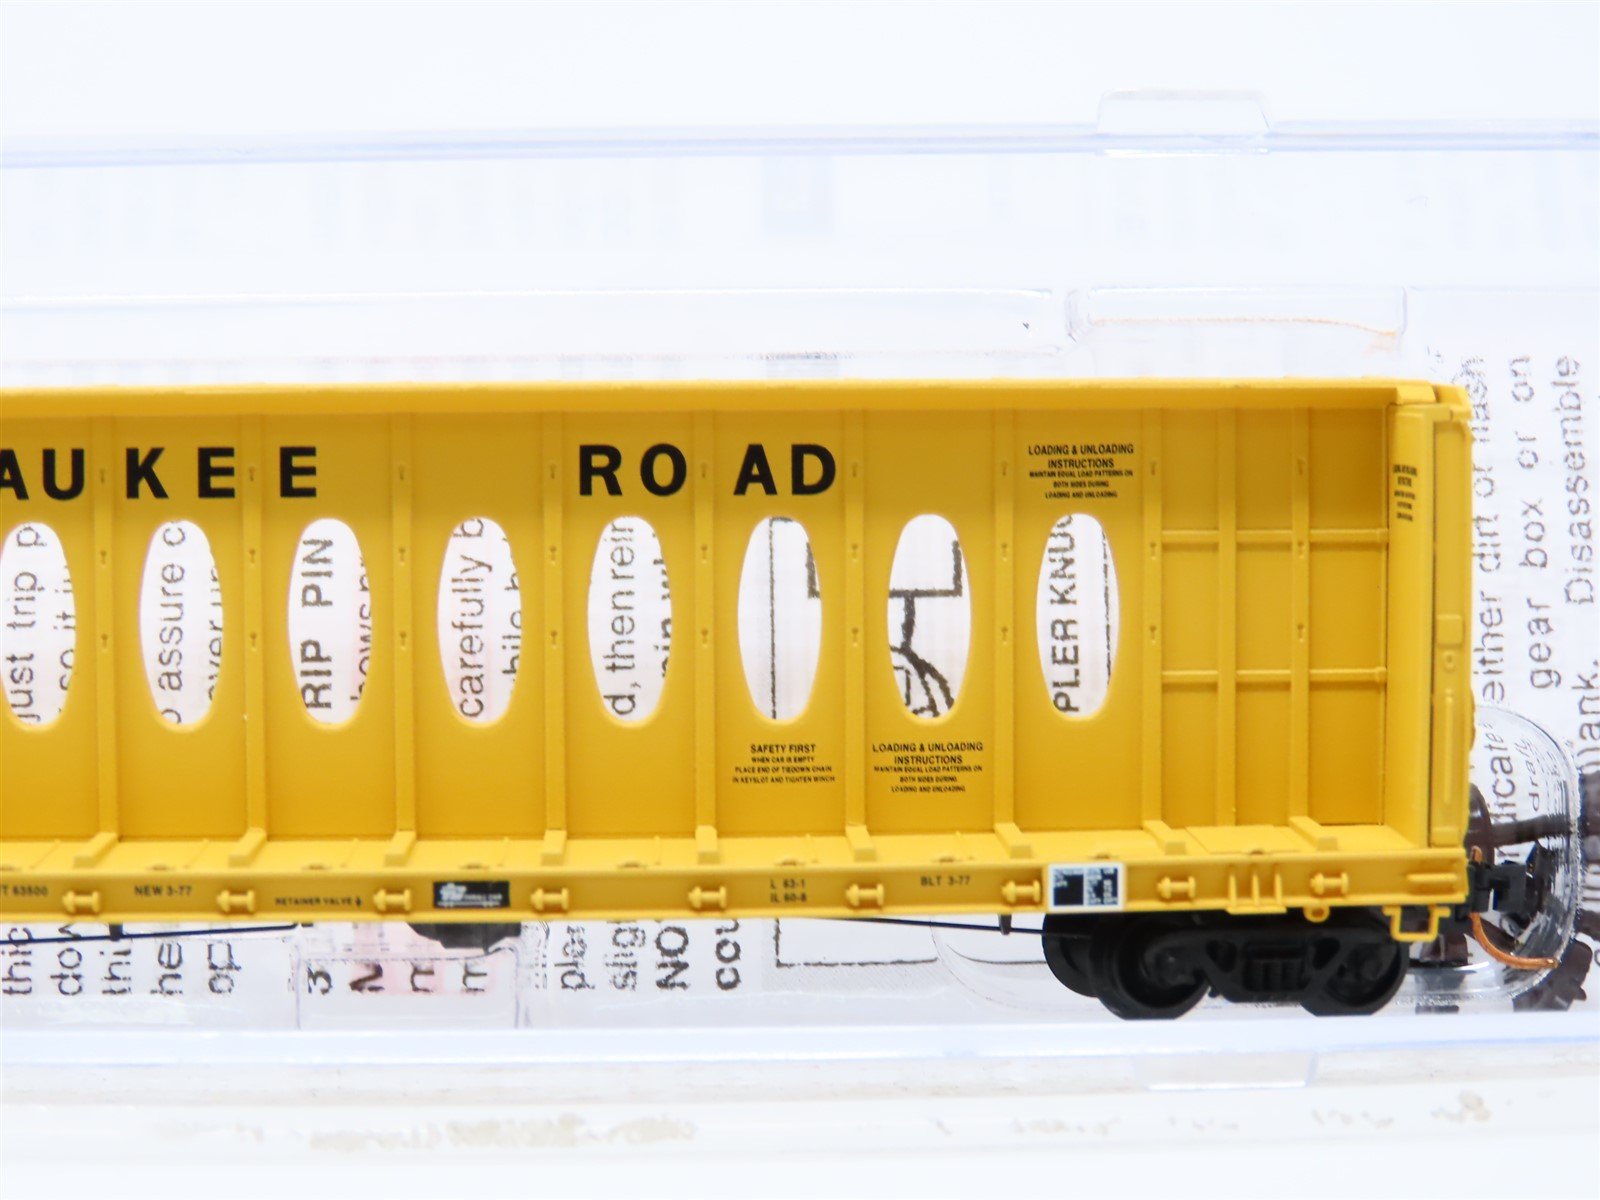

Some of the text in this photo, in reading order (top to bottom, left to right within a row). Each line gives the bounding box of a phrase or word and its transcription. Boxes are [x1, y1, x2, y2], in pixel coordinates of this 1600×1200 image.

[580, 443, 836, 497] ROAD
[1028, 443, 1134, 456] LOADING & UNLOADING
[1029, 470, 1056, 478] MAINTAIN
[1057, 470, 1076, 478] EQUAL
[1048, 458, 1115, 469] INSTRUCTIONS
[1550, 356, 1595, 604] Disassemble
[1518, 498, 1548, 568] box
[6, 571, 46, 629] trip
[301, 538, 334, 608] PIN
[157, 563, 185, 692] assure
[451, 553, 493, 718] carefully
[603, 590, 636, 674] then
[1473, 591, 1505, 702] either
[1527, 597, 1561, 689] gear
[1051, 618, 1081, 712] PLER
[750, 743, 816, 754] SAFETY FIRST
[872, 742, 984, 753] LOADING & UNLOADING
[894, 755, 963, 765] INSTRUCTIONS
[134, 885, 192, 896] NEW 3-77
[275, 896, 352, 906] RETAINER VALVE
[770, 878, 806, 889] L 63-1
[920, 875, 971, 886] BLT 3-77
[655, 920, 691, 991] NO
